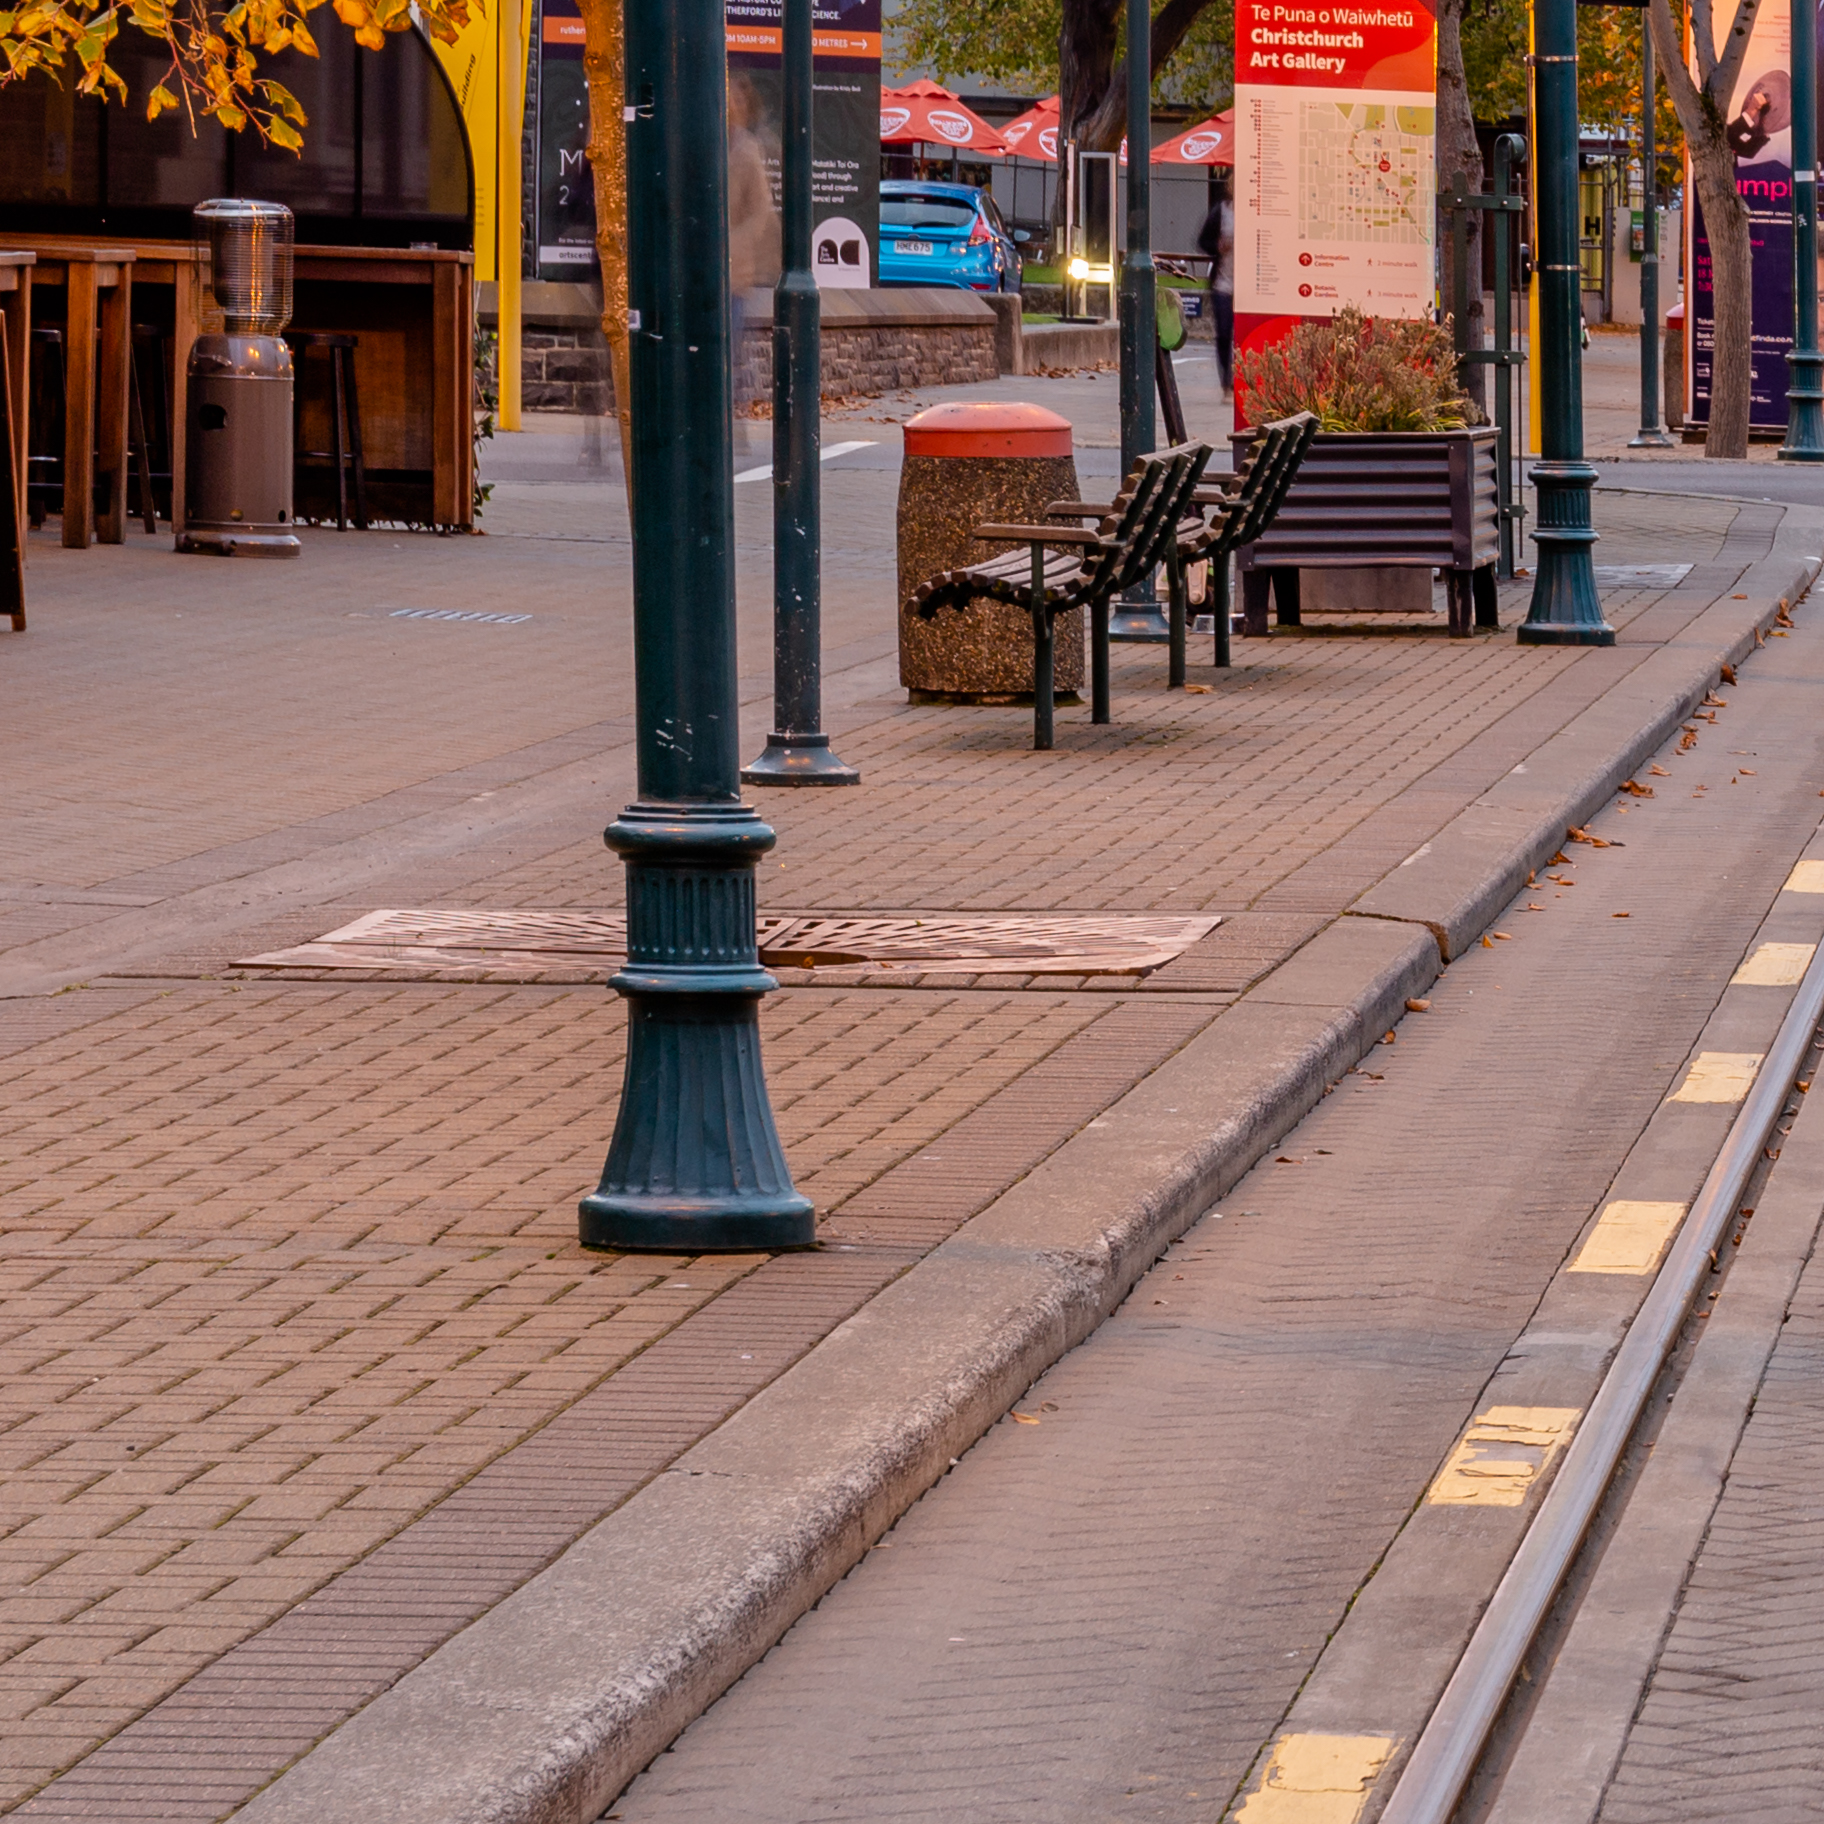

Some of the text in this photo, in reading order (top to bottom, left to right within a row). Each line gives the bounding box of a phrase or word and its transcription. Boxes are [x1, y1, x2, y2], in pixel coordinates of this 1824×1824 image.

[726, 6, 841, 20] THERFORD'S LI CIENCE.
[1251, 4, 1413, 27] Te Puna o Waiwhetū
[819, 39, 848, 49] METRES
[1251, 28, 1364, 48] Christchurch
[1250, 51, 1346, 74] Art Gallery
[559, 251, 591, 260] artscent
